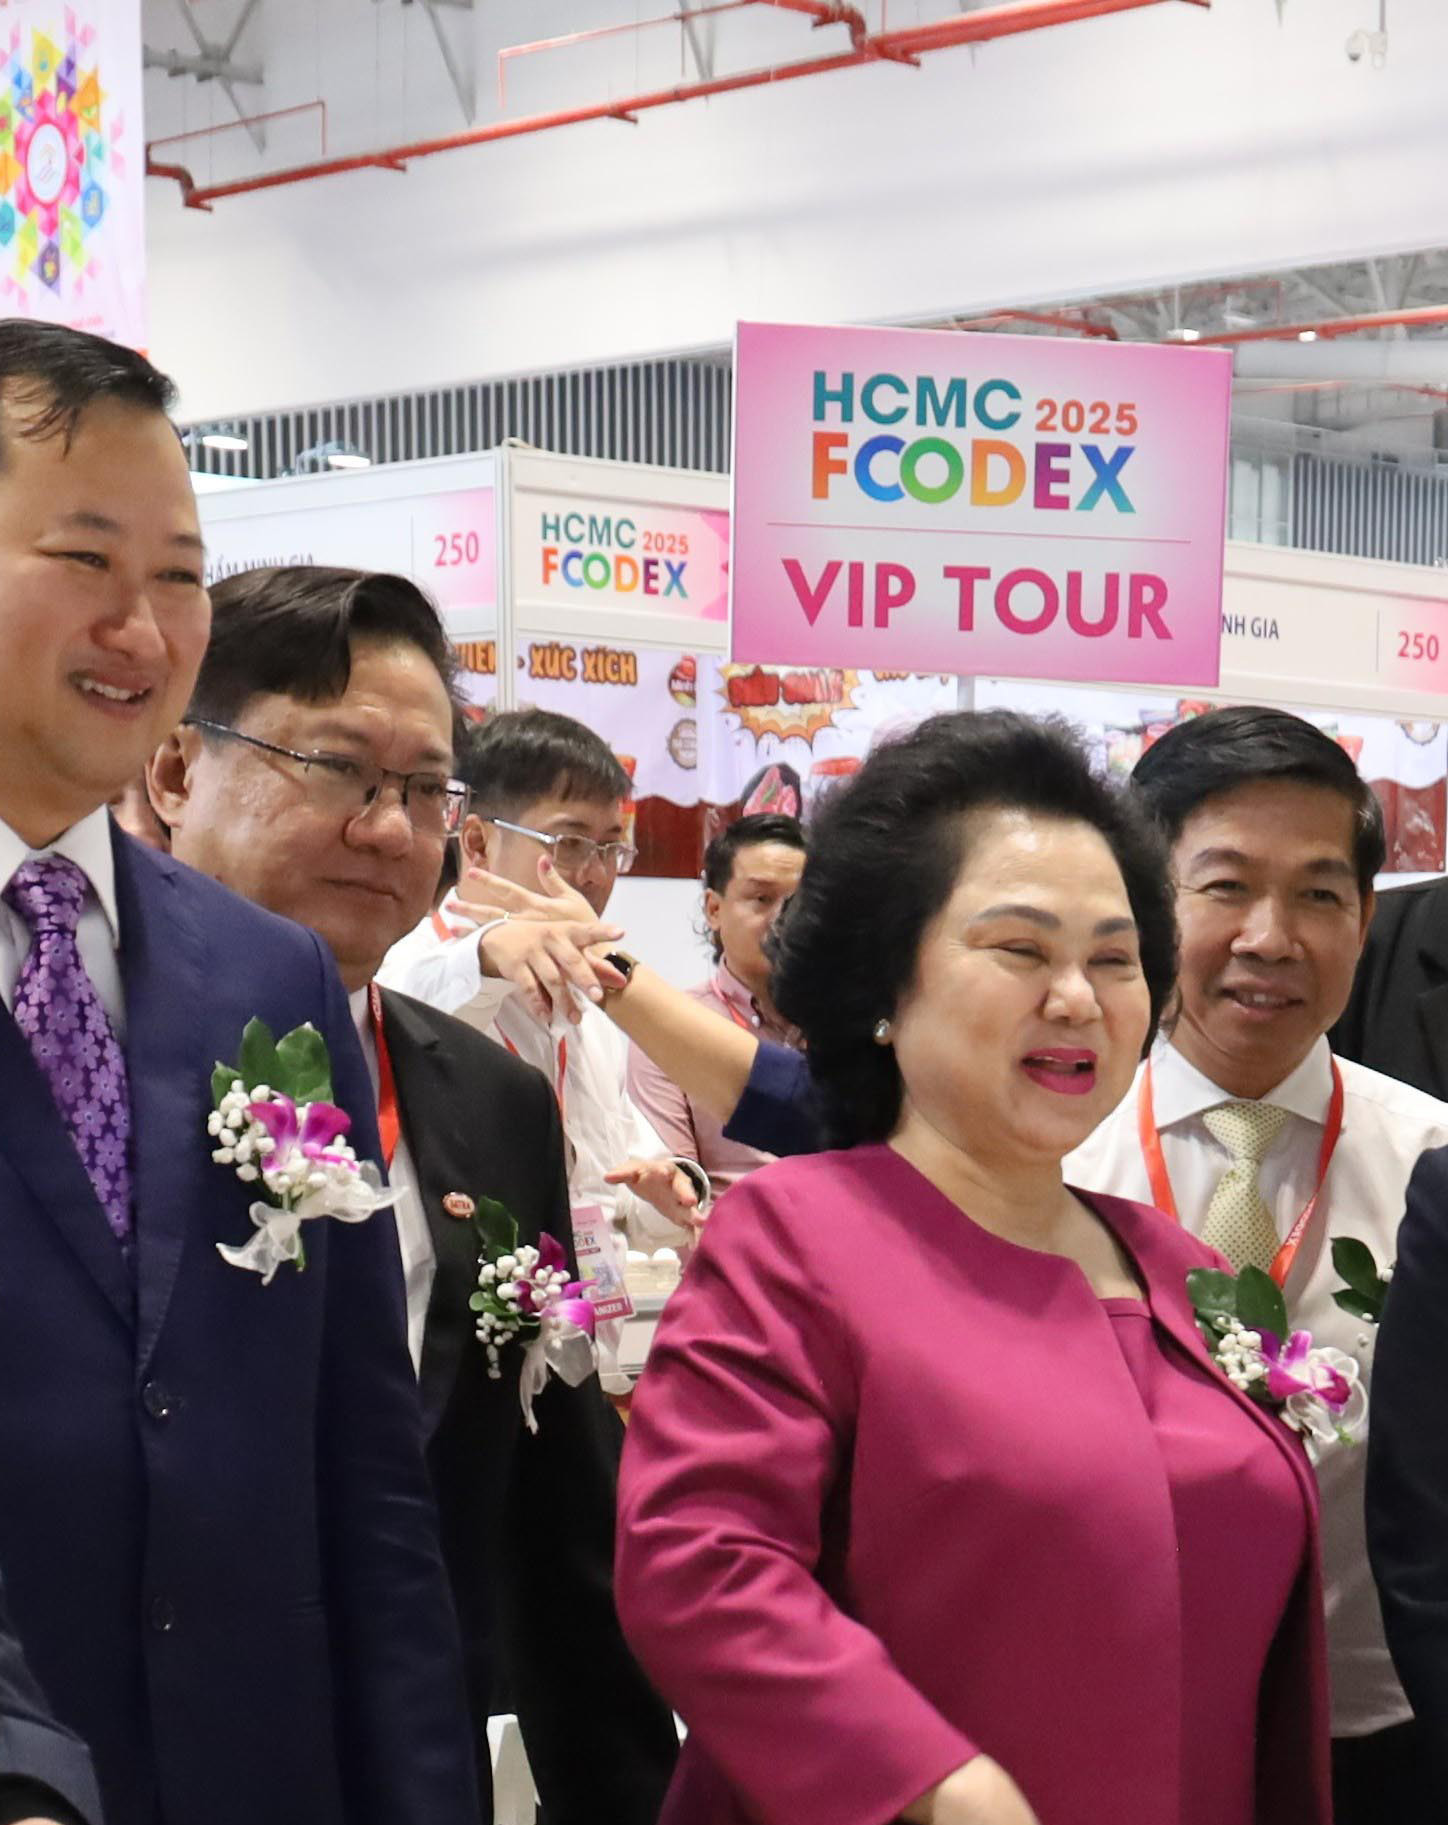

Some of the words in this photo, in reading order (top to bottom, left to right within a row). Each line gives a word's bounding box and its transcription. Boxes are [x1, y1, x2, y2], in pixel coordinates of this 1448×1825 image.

[812, 371, 1022, 430] HCMC
[1035, 398, 1138, 436] 2025
[434, 530, 480, 567] 250
[541, 512, 636, 549] HCMC
[643, 531, 689, 555] 2025
[781, 558, 916, 628] VIP
[943, 565, 1174, 641] TOUR
[1221, 614, 1246, 636] NH
[1251, 616, 1280, 640] GIA
[1397, 630, 1440, 662] 250
